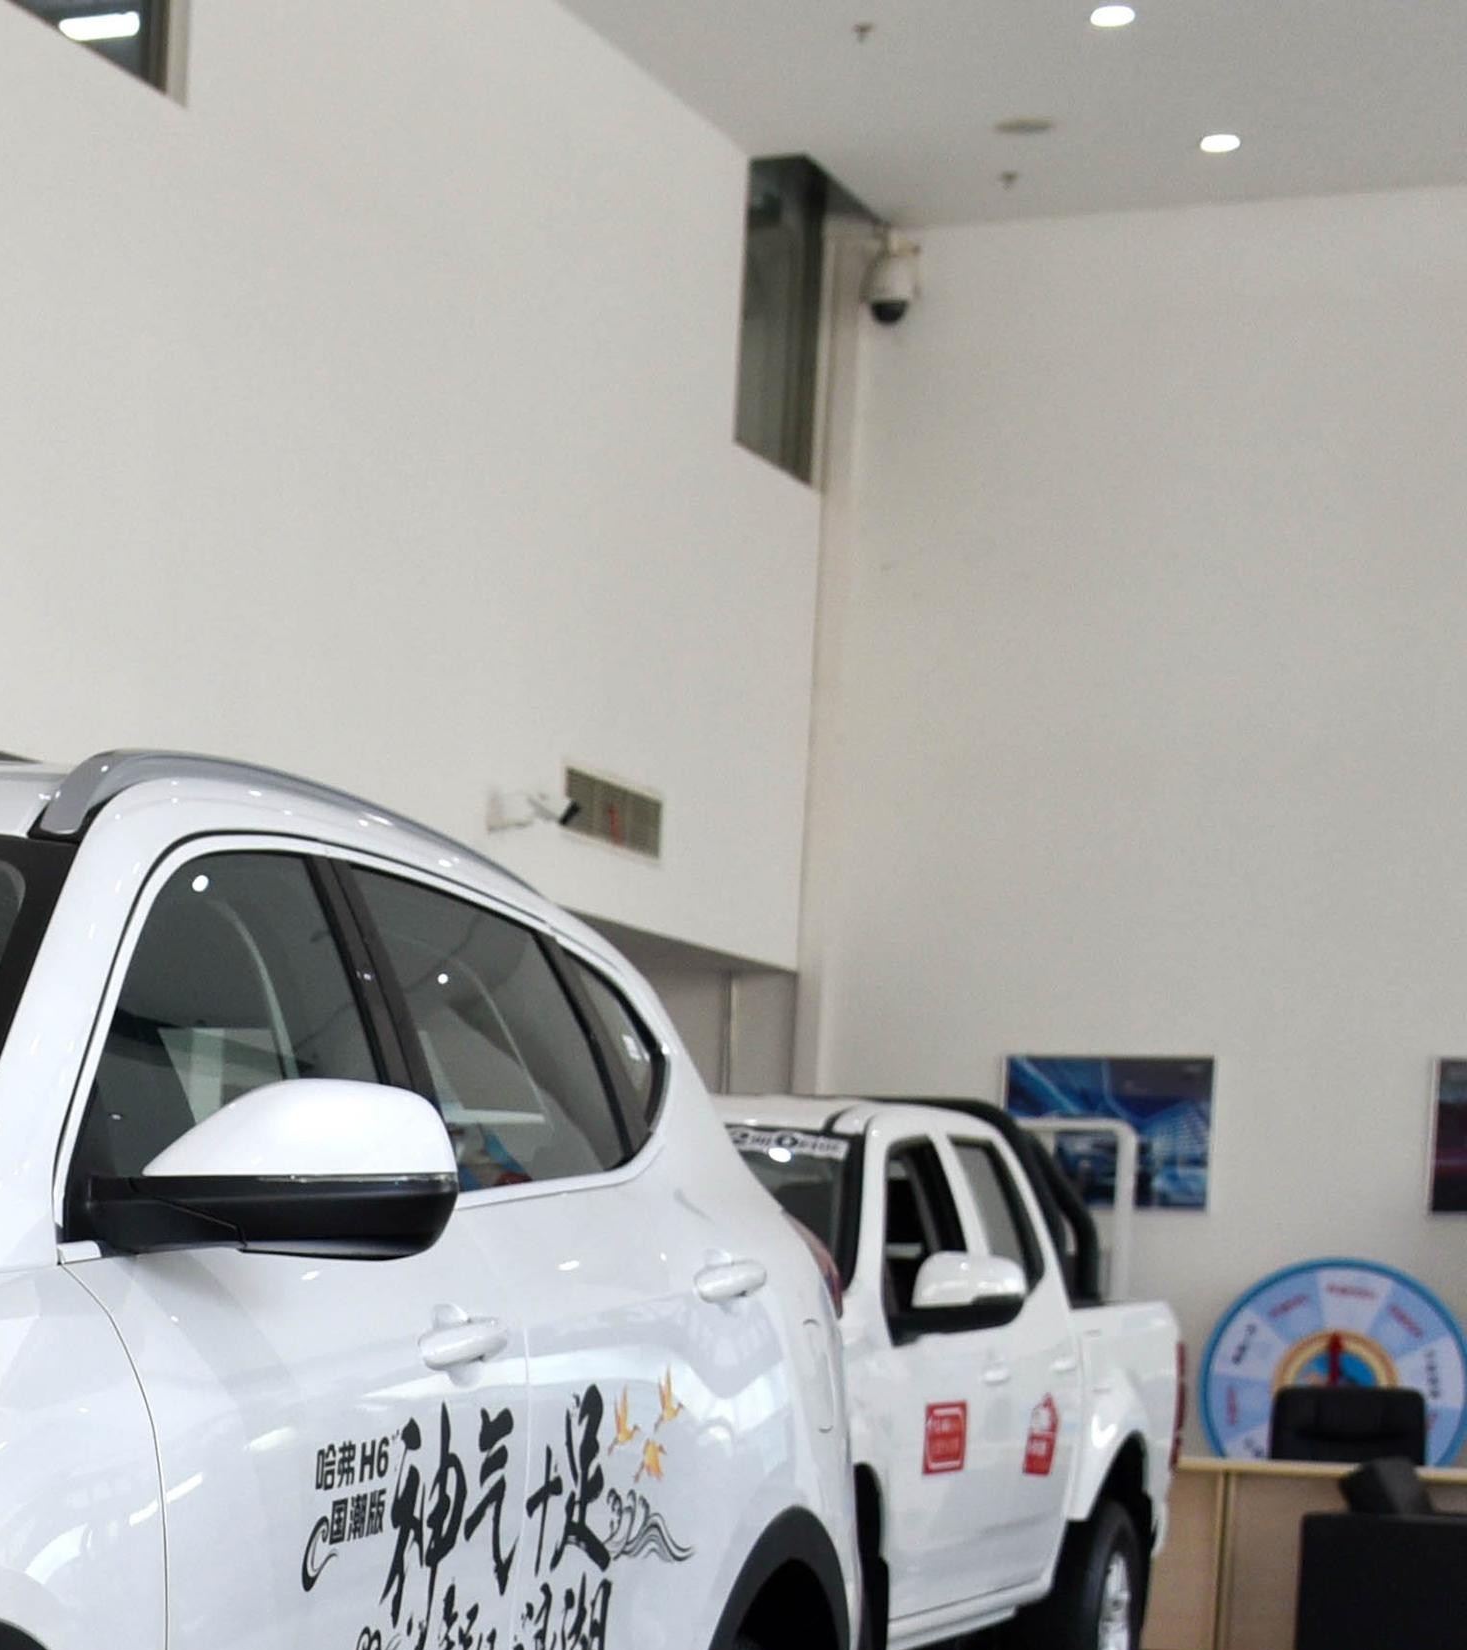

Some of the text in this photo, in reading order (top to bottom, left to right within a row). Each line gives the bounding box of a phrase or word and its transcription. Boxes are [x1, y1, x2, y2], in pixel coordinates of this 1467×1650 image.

[315, 1436, 390, 1491] 哈弗 H6
[329, 1488, 387, 1545] 国潮版
